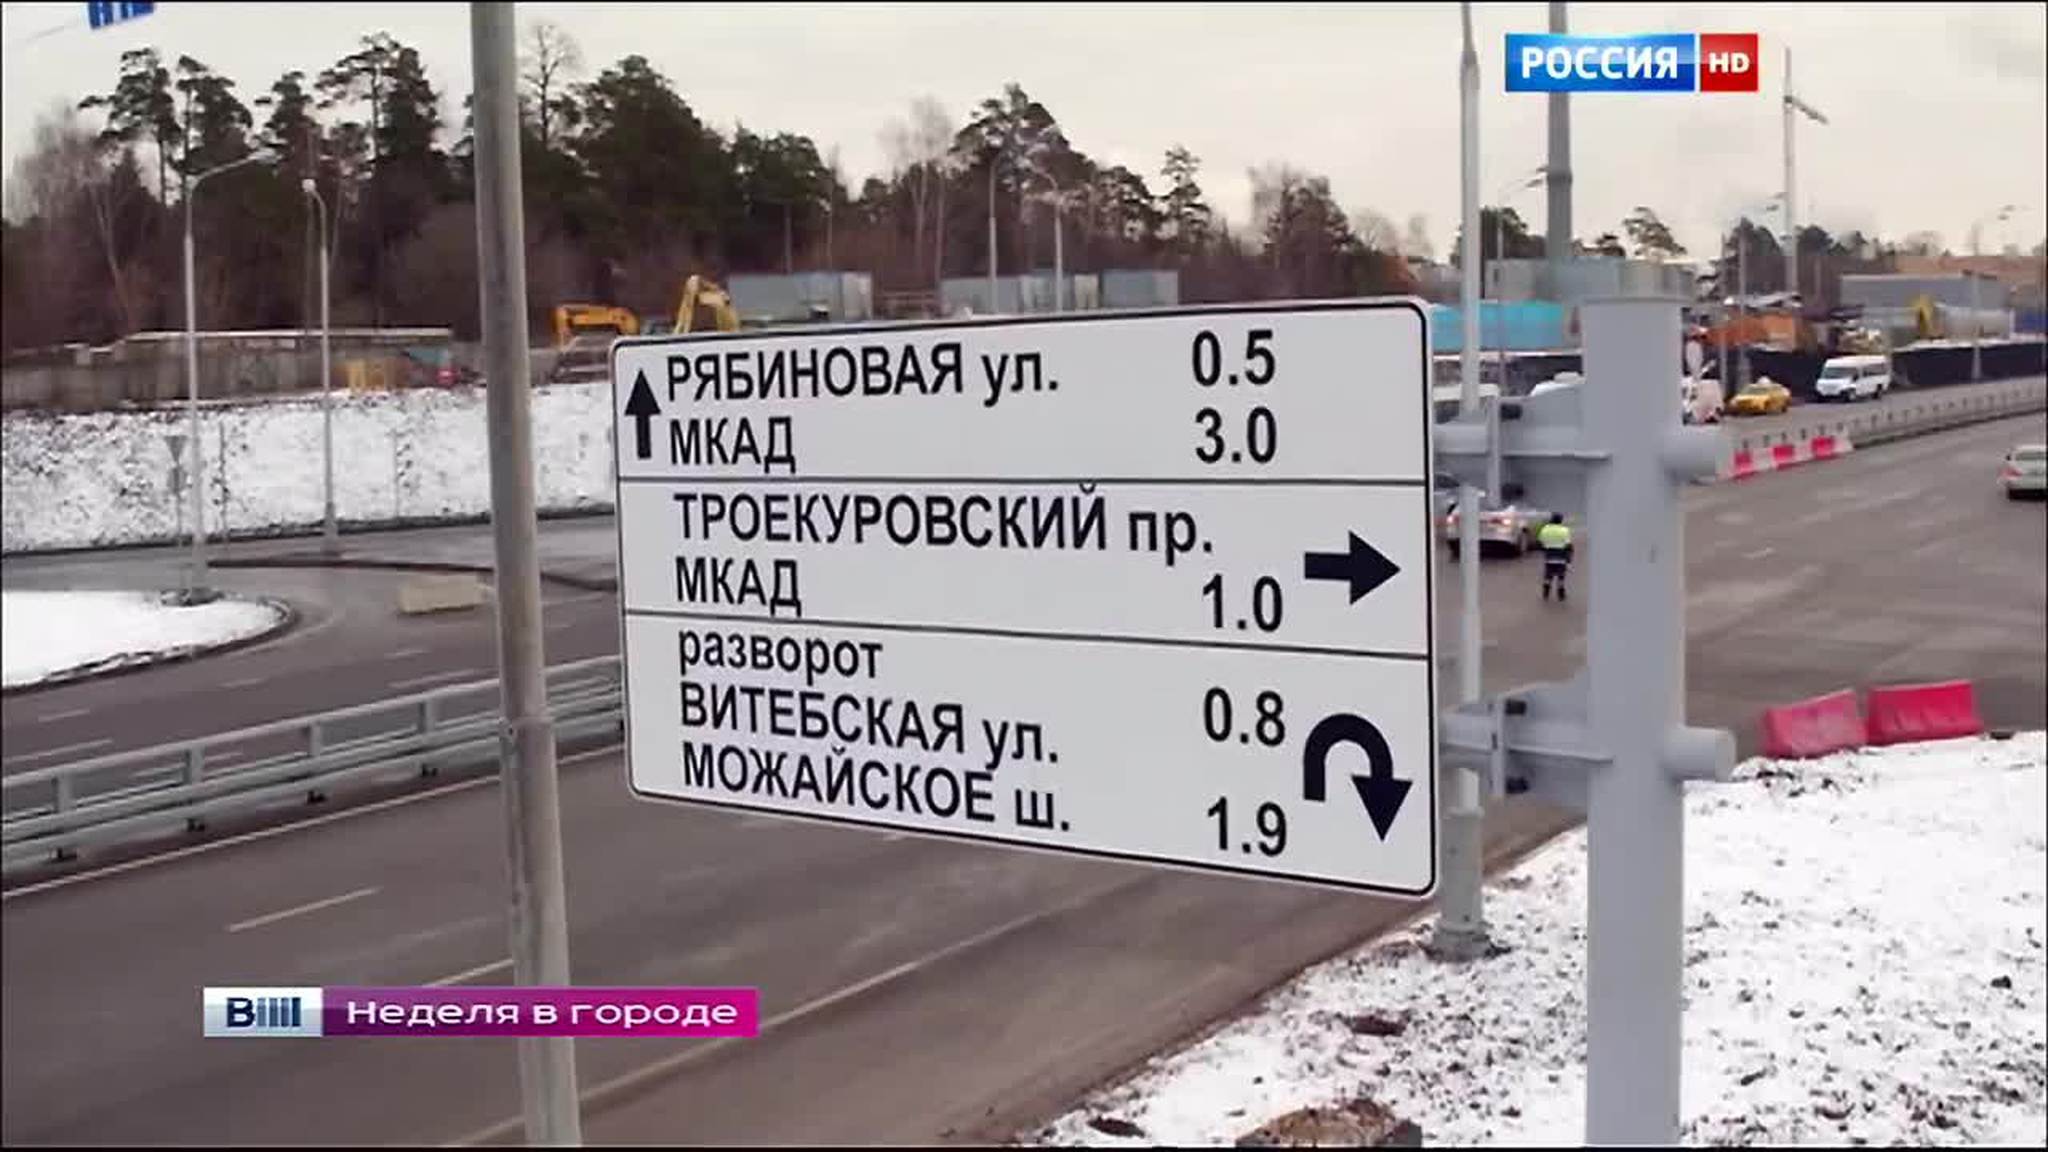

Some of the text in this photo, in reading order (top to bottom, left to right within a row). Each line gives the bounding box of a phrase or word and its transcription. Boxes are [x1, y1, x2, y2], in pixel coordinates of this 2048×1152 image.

[667, 329, 1277, 408] РЯБИНОВАЯ ул. 0.5
[669, 406, 1278, 475] МКАД 3.0
[673, 482, 1213, 567] ТРОЕКУРОВСКИЙ пр.
[675, 556, 1284, 634] МКАД 1.0
[678, 630, 884, 688] разворот
[680, 680, 1287, 772] ВИТЕБСКАЯ ул. 0.8
[683, 740, 1288, 859] МОЖАЙСКОЕ ш. 1.9
